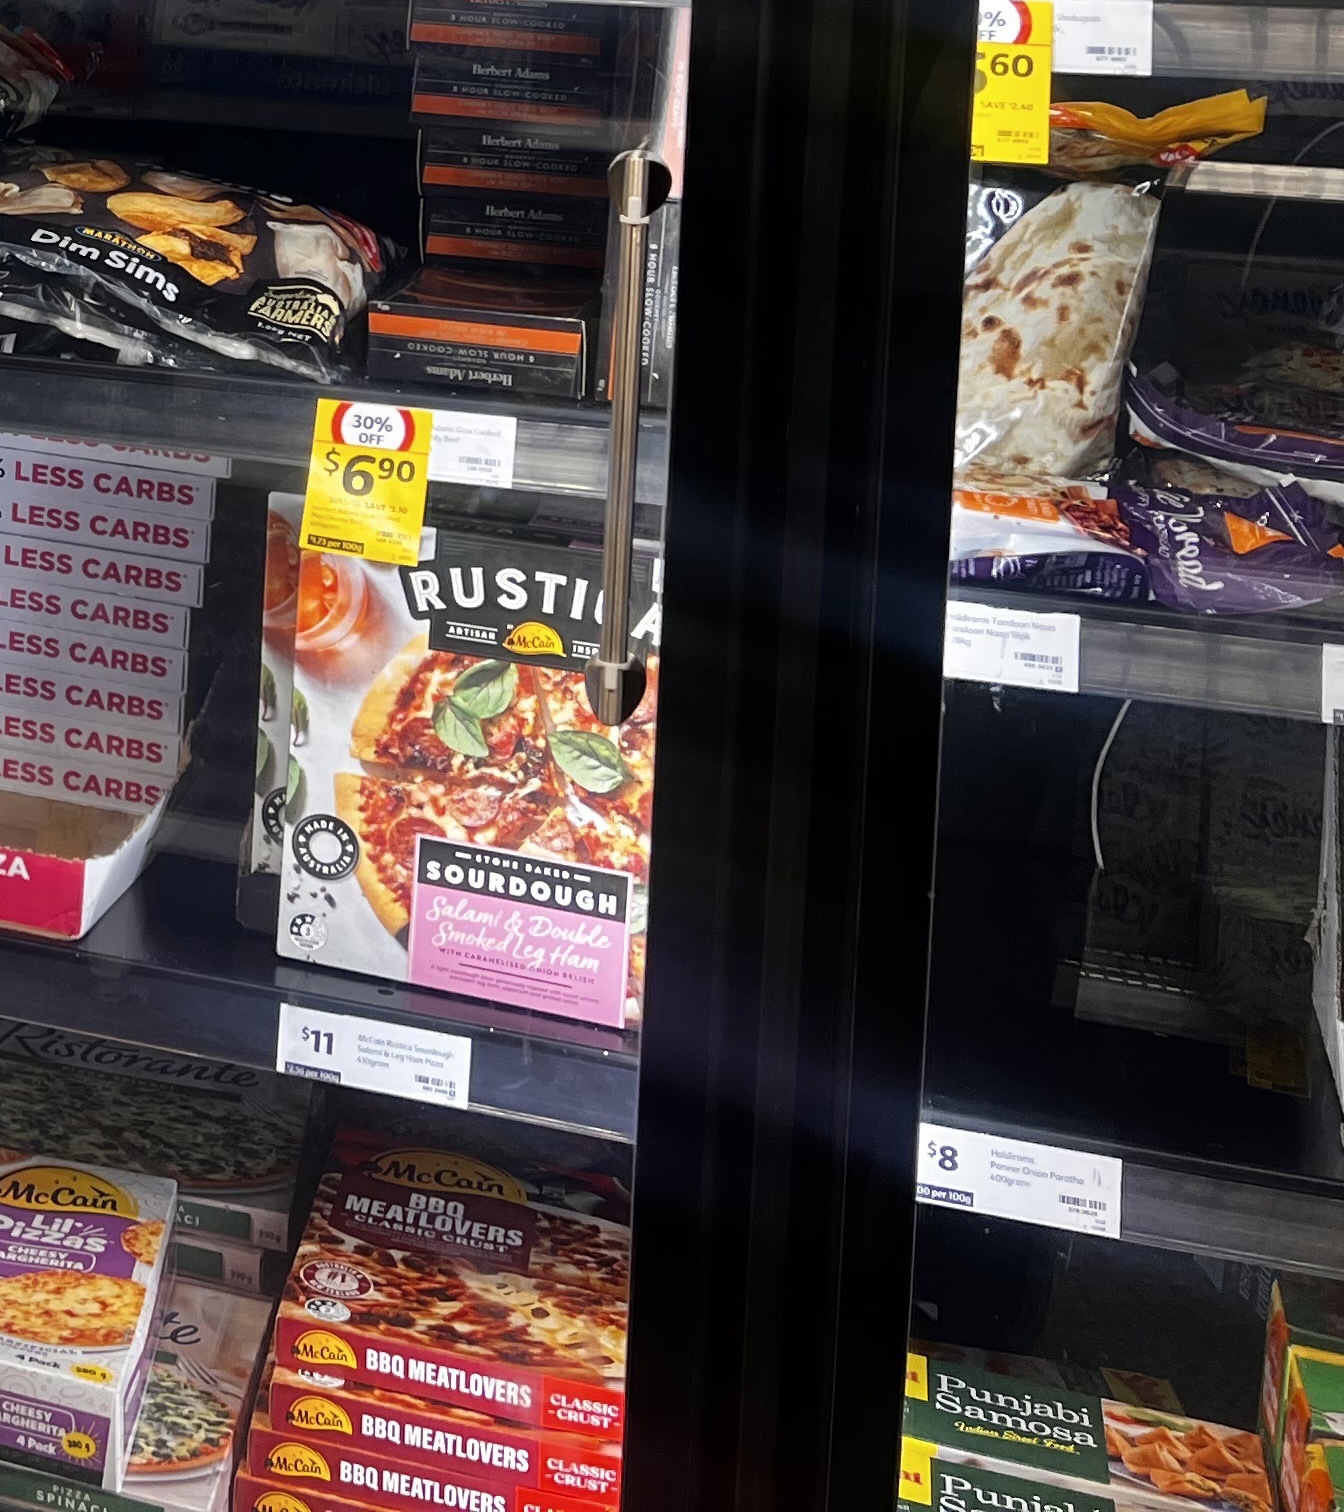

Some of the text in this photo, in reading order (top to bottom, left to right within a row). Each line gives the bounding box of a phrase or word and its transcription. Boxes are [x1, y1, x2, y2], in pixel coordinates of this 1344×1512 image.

[472, 63, 550, 81] Herbert Adams
[30, 228, 181, 303] Dim Sims
[352, 413, 393, 434] 30%
[358, 432, 385, 445] OFF
[15, 461, 84, 490] LESS
[476, 854, 570, 879] STONE BAKED
[426, 860, 617, 915] SOURDOUGH
[425, 896, 612, 948] Salami & Double
[432, 922, 600, 973] Smoked Leg Ham
[301, 1026, 336, 1057] $11
[927, 1140, 959, 1172] $8
[931, 1189, 972, 1206] per 100g
[7, 1243, 69, 1260] CHEESY
[365, 1348, 532, 1409] BBQ MEATLOVERS
[550, 1393, 619, 1418] CLASSIC
[935, 1372, 1094, 1429] Punjabi
[556, 1407, 612, 1428] CRUST
[935, 1391, 1098, 1448] Samosa
[361, 1414, 530, 1473] BBQ MEATLOVERS
